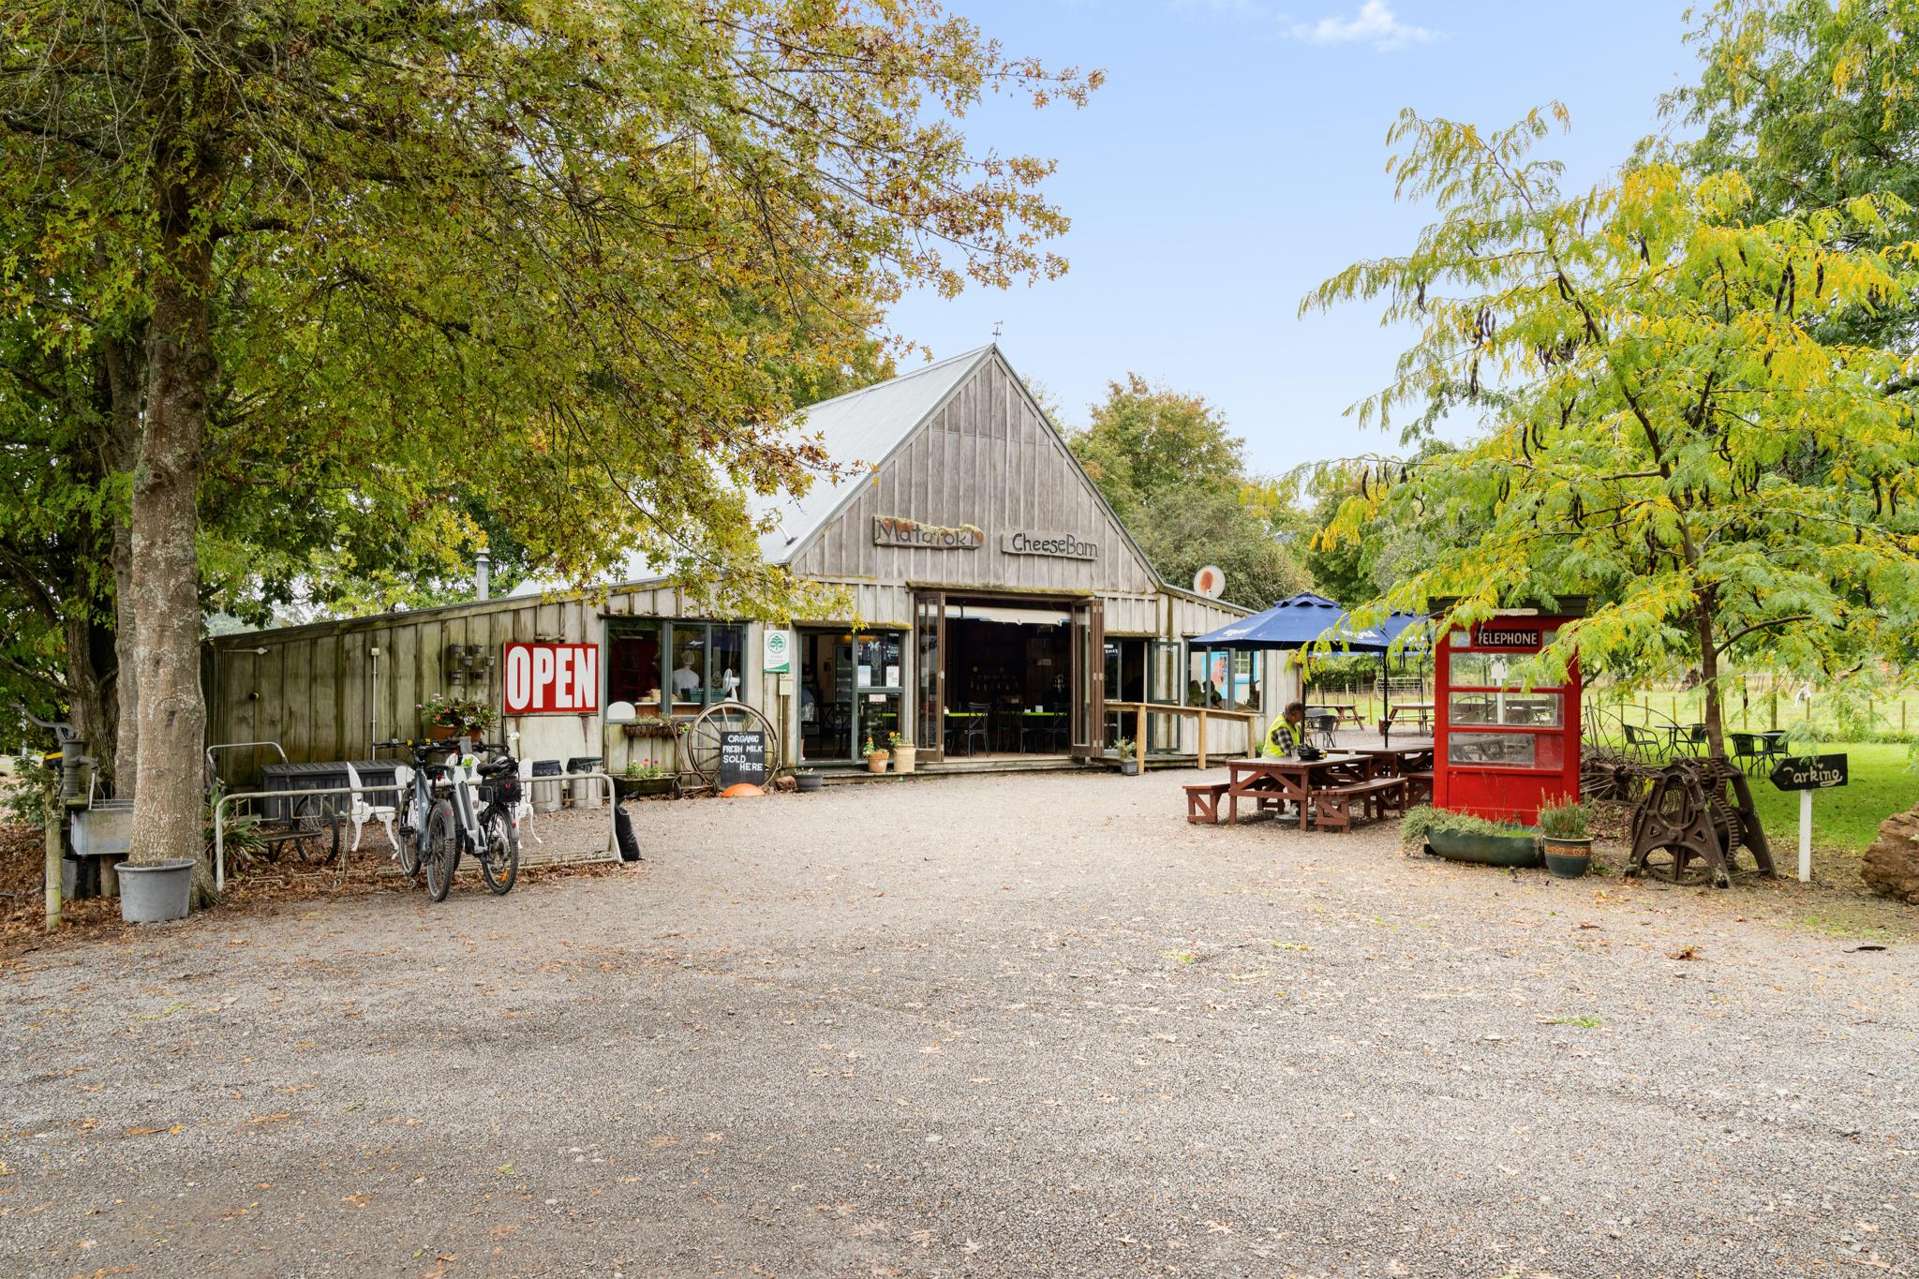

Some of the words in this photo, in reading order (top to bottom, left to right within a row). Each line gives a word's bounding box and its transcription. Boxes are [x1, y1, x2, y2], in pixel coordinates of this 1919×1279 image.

[1478, 632, 1537, 645] TELEPHONE
[507, 646, 596, 711] OPEN
[727, 734, 760, 743] ORGANIC
[722, 745, 743, 754] FRESH
[746, 745, 763, 753] MILK
[722, 754, 747, 764] SOLD
[739, 762, 763, 772] HERE
